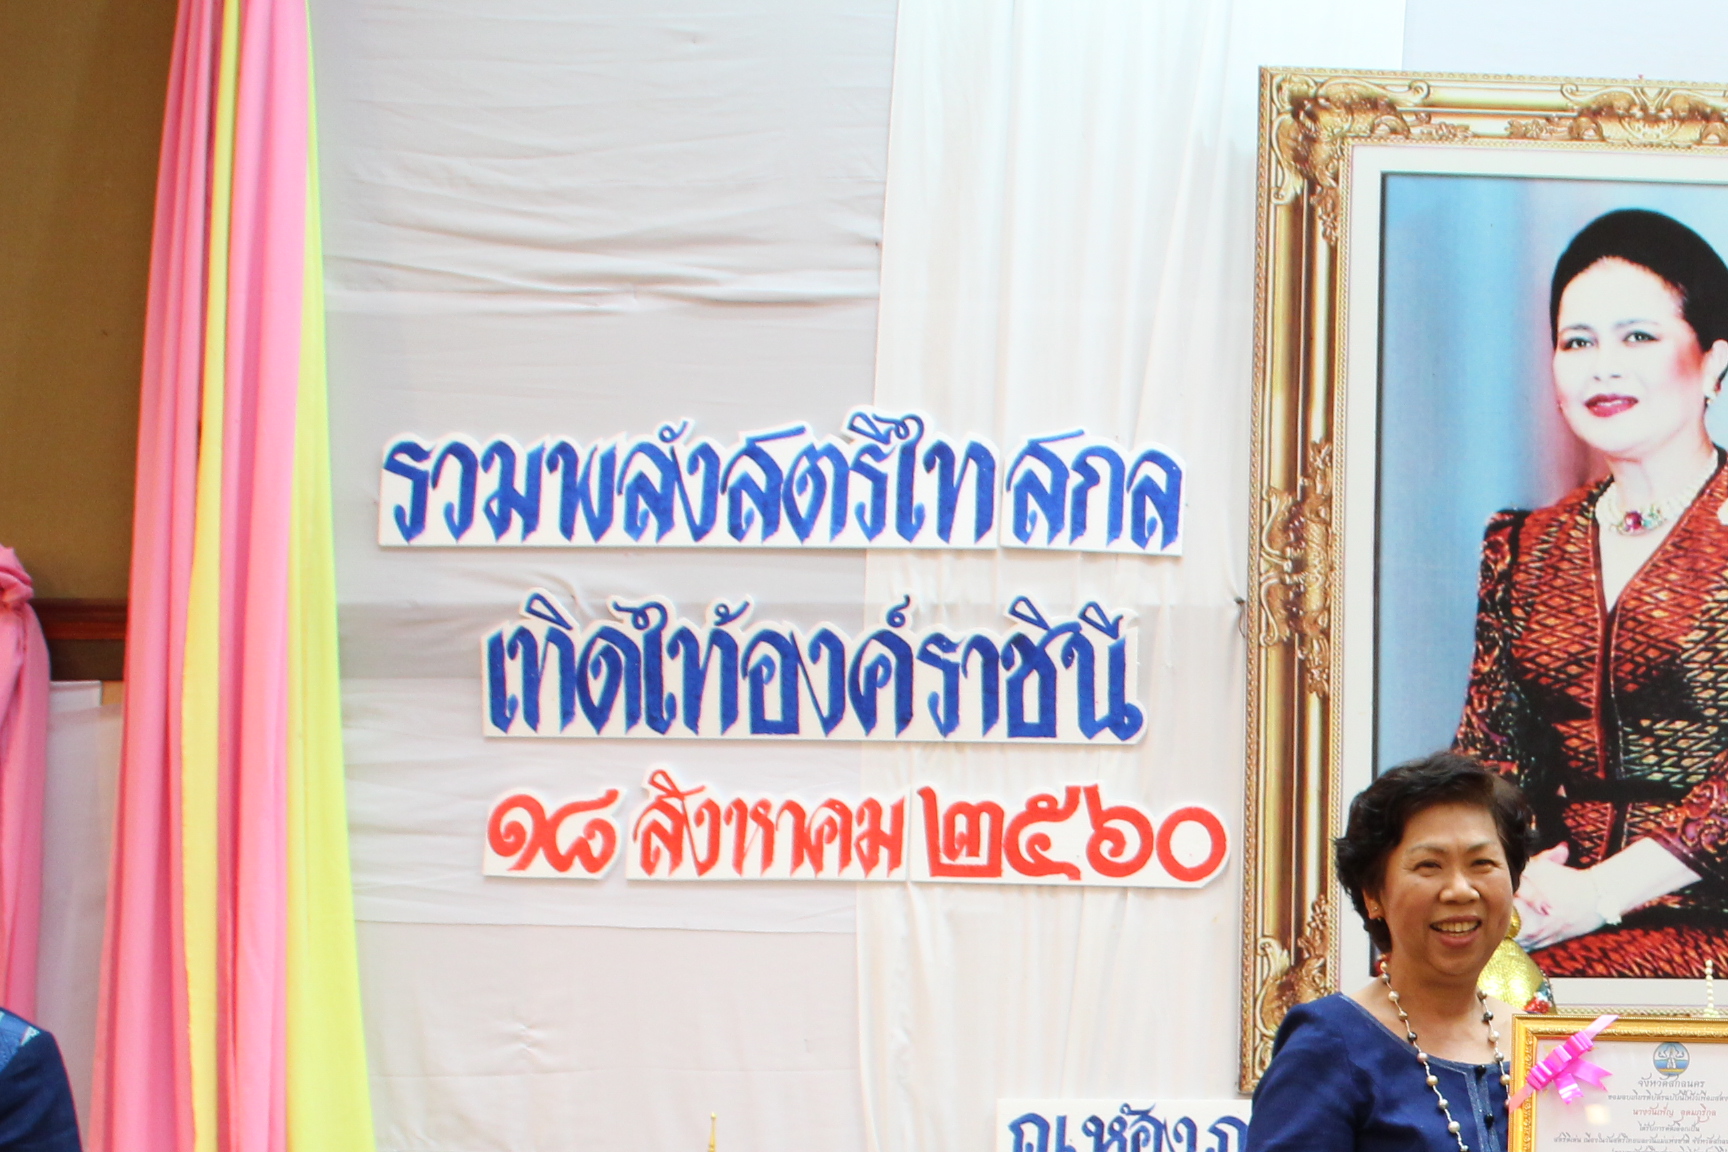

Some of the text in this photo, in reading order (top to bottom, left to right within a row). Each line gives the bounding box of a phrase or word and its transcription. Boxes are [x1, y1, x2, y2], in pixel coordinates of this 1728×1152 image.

[487, 592, 1144, 741] เทิดไท้องค์ราชินี
[487, 769, 1228, 883] ๑๘ สิงหาคม ๒๕๖๐
[1637, 1073, 1706, 1088] จังหวัดสกลนคร
